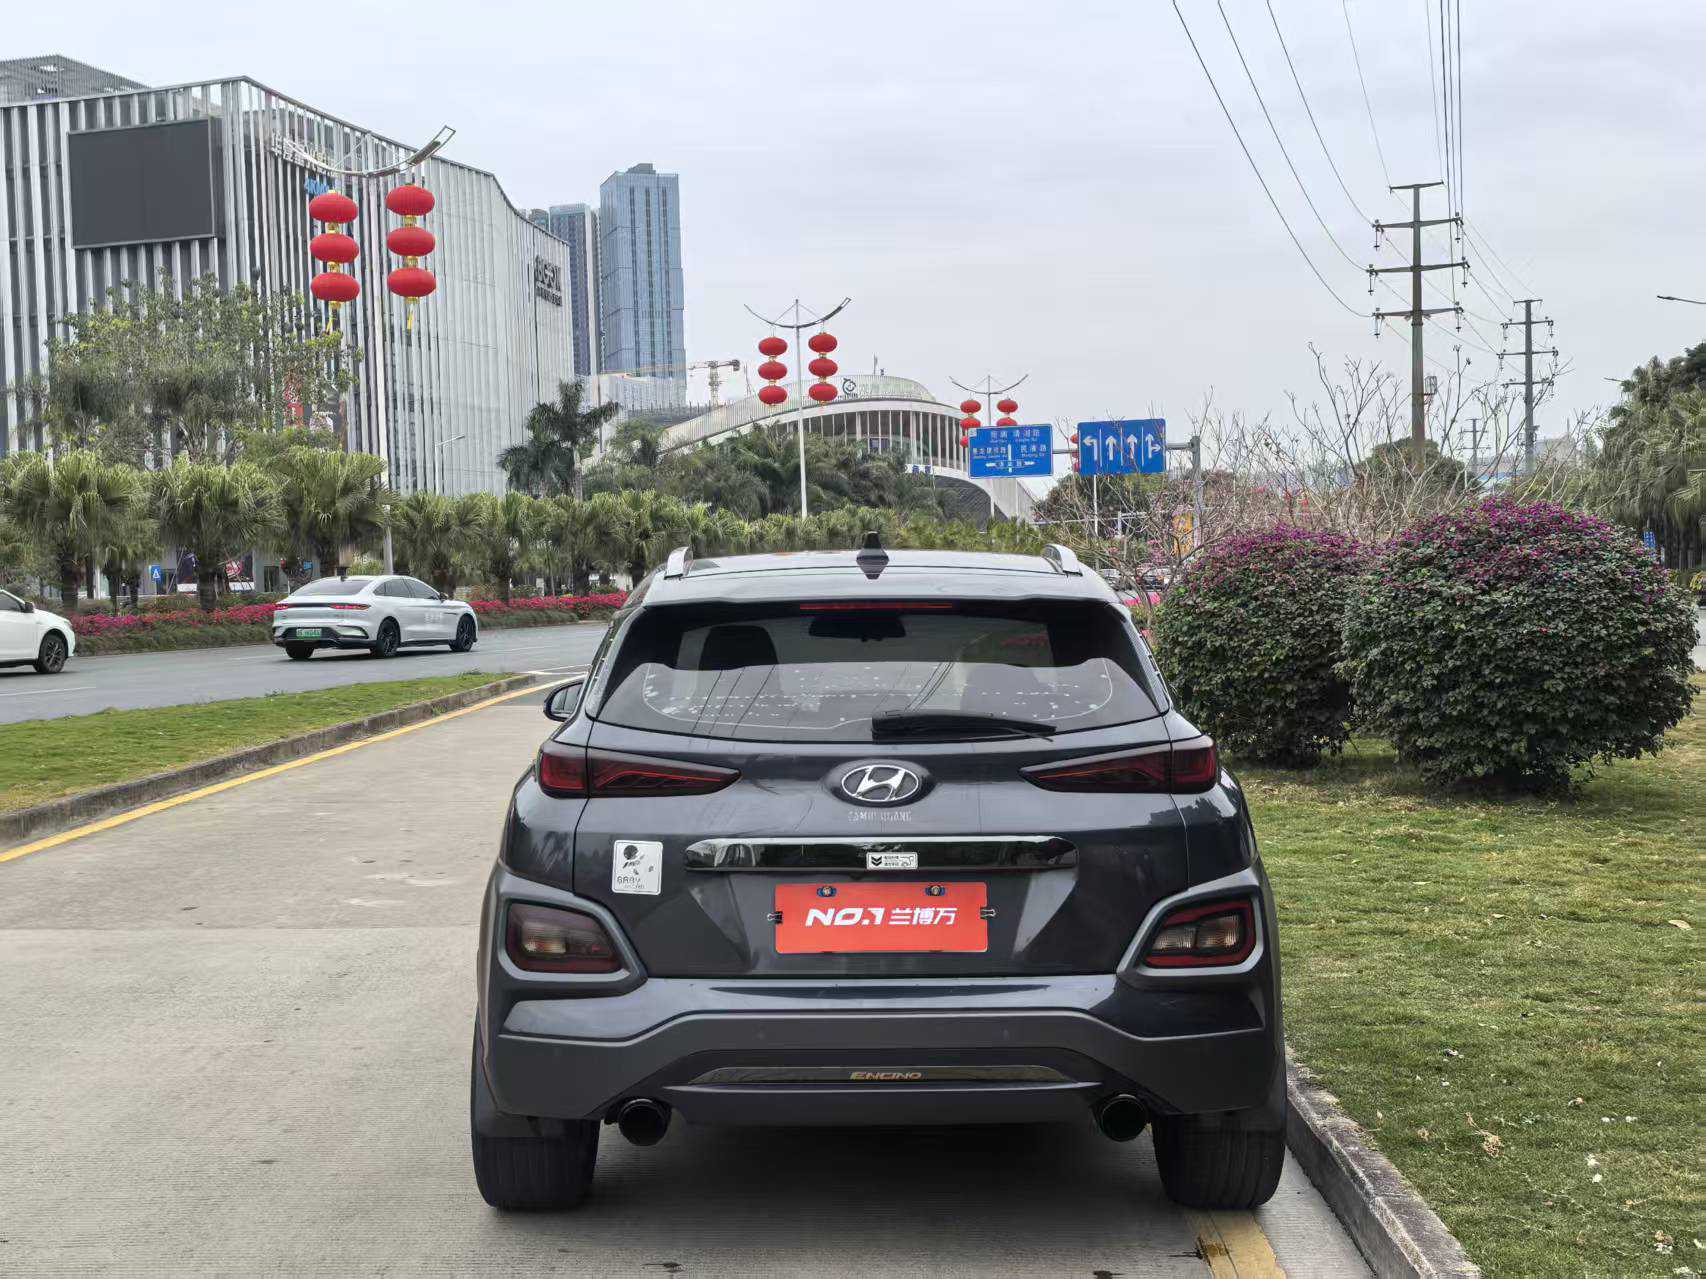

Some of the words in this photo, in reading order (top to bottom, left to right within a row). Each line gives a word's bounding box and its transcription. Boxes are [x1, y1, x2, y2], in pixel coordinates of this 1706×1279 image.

[805, 907, 885, 926] NO.1
[888, 906, 958, 926] 兰博万
[849, 1071, 923, 1080] ENCINO
